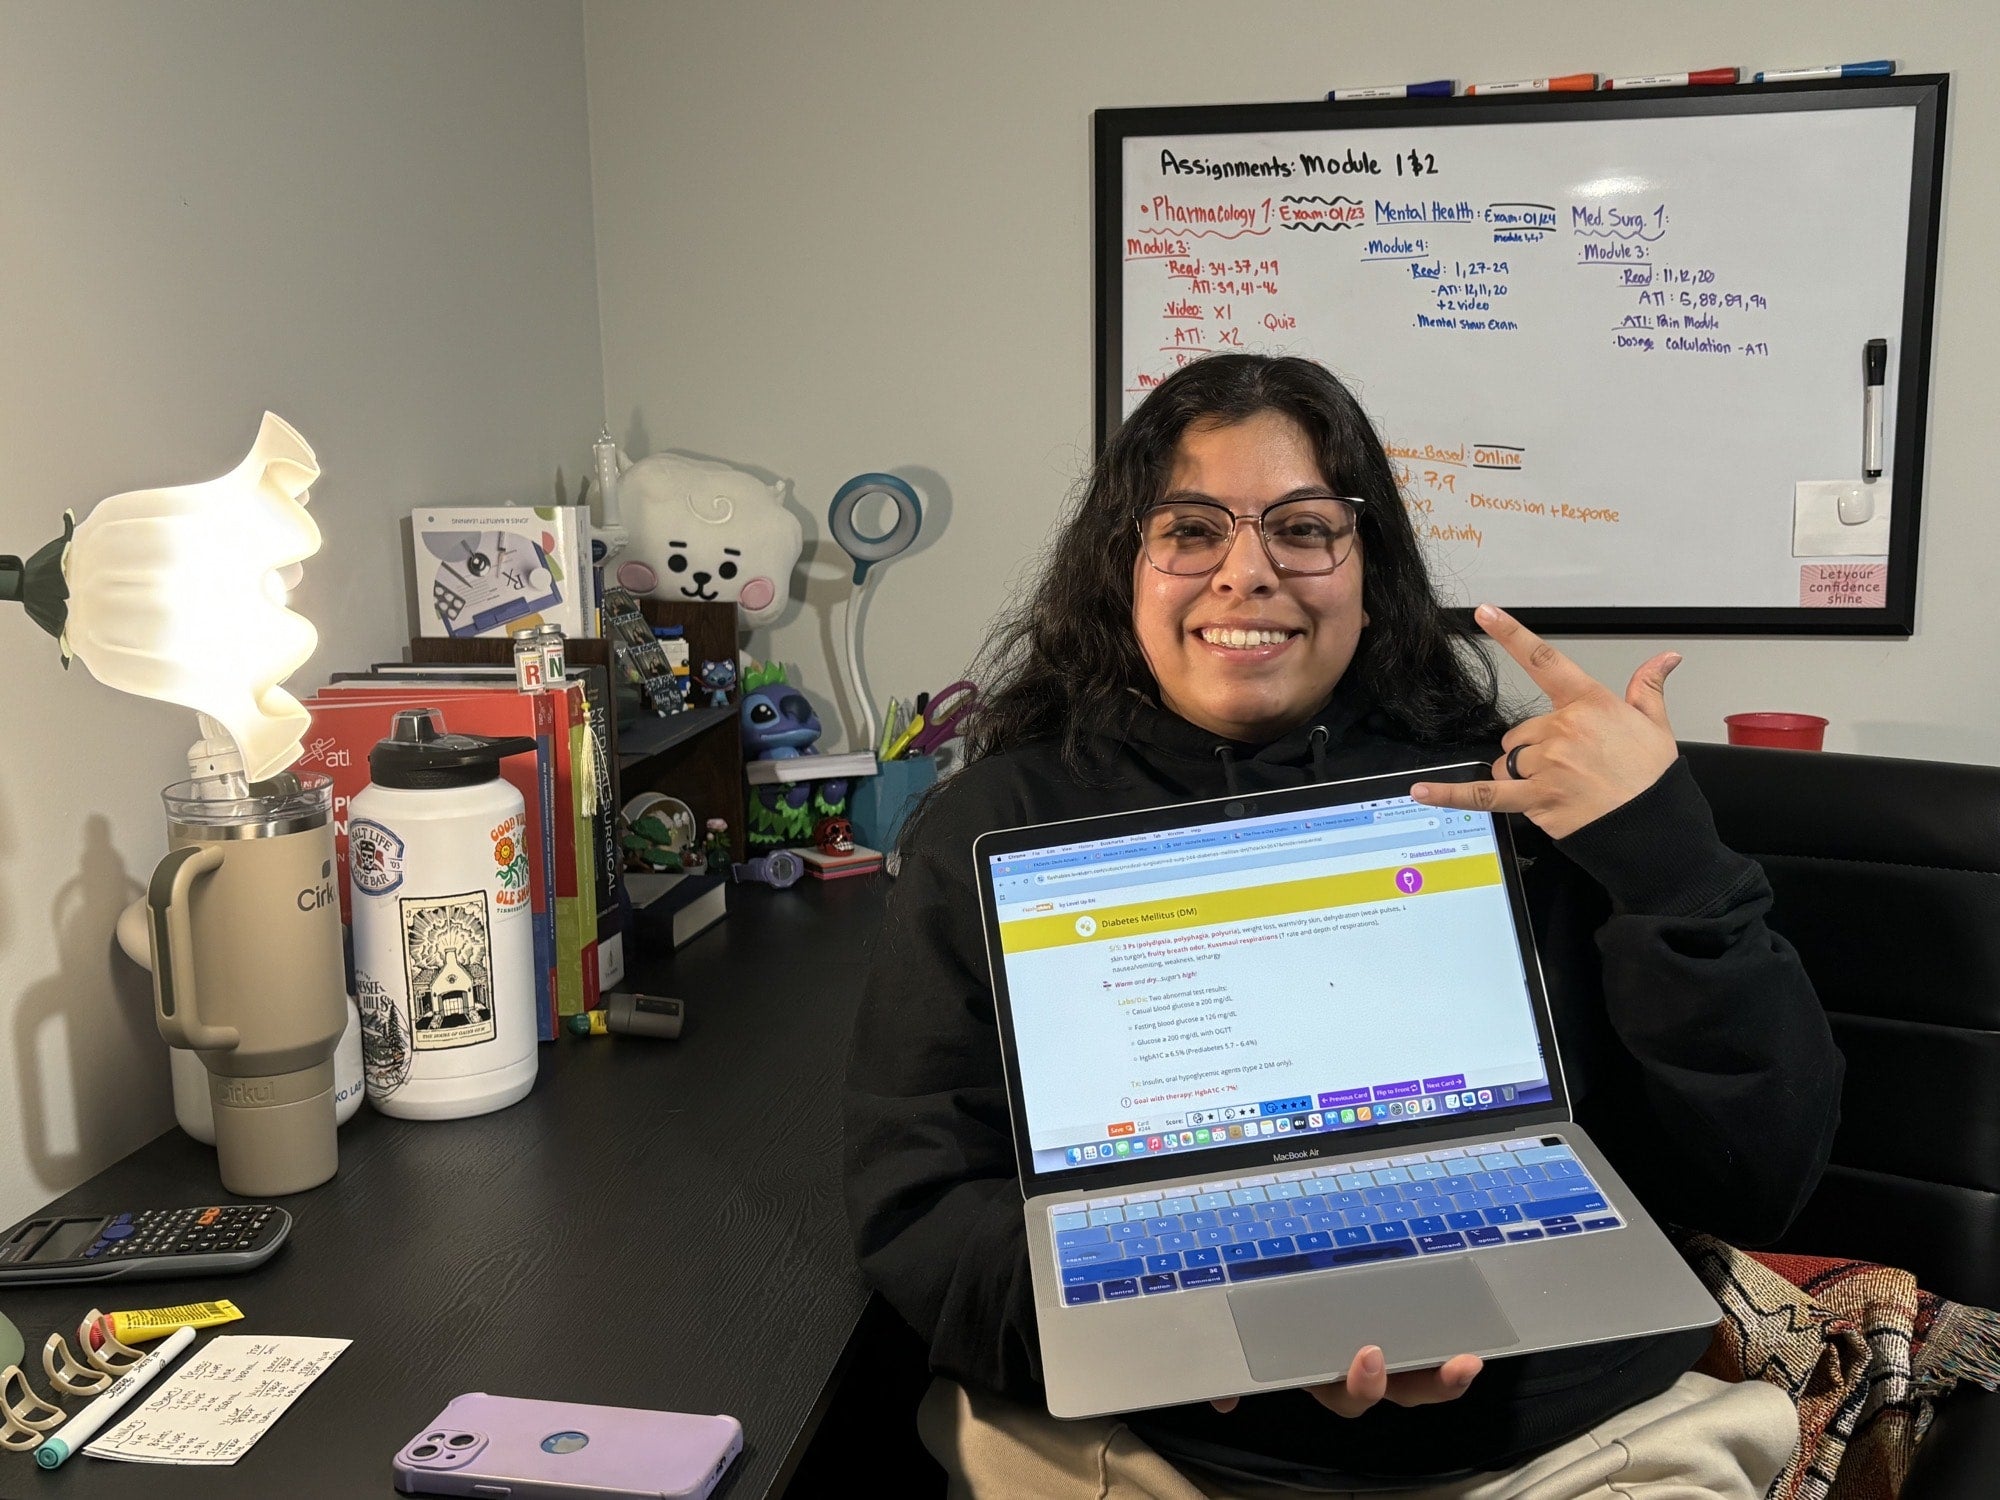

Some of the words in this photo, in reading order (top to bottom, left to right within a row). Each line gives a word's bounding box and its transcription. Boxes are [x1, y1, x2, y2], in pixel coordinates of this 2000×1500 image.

[1161, 149, 1296, 181] Assignments:
[1300, 148, 1381, 176] Module
[1153, 195, 1255, 227] Pharmacology
[1375, 199, 1427, 223] Mental
[1571, 205, 1604, 228] Med.
[1608, 207, 1647, 233] Surg.
[1127, 237, 1173, 255] Module
[1369, 237, 1412, 254] Module
[1584, 241, 1632, 260] Module
[1264, 313, 1296, 332] Quiz
[1418, 313, 1456, 328] Mental
[1488, 319, 1518, 330] Exam
[1685, 313, 1719, 329] Module
[1474, 449, 1521, 464] Online
[1470, 493, 1545, 516] Discussion
[1430, 522, 1482, 548] Activity
[1820, 569, 1841, 580] Let
[1843, 570, 1874, 581] your
[1809, 581, 1880, 592] confidence
[1827, 594, 1862, 604] shine
[525, 664, 541, 685] R
[549, 657, 563, 678] N
[490, 817, 515, 842] GOOD
[369, 830, 392, 851] LIFE
[371, 874, 389, 887] BAR
[297, 883, 336, 912] Cirk
[496, 890, 515, 905] OLE
[1102, 916, 1139, 928] Diabetes
[1141, 911, 1174, 922] Mellitus
[1177, 908, 1197, 918] (DM)
[1163, 991, 1191, 999] abnormal
[1132, 1007, 1152, 1015] Casual
[1153, 1004, 1170, 1012] blood
[1172, 1002, 1194, 1010] glucose
[1213, 996, 1232, 1004] mg/dL
[1135, 1023, 1156, 1031] Fasting
[1157, 1019, 1174, 1027] blood
[1176, 1017, 1199, 1025] glucose
[1218, 1011, 1237, 1019] mg/dL
[1137, 1037, 1161, 1045] Glucose
[1180, 1032, 1199, 1041] mg/dL
[1140, 1053, 1163, 1062] HgbA1C
[1221, 1068, 1241, 1076] agents
[1134, 1097, 1148, 1105] Goal
[1195, 1087, 1220, 1097] HgbA1C
[1329, 1094, 1352, 1102] Previous
[1273, 1150, 1308, 1162] MacBook
[1309, 1148, 1319, 1156] Air
